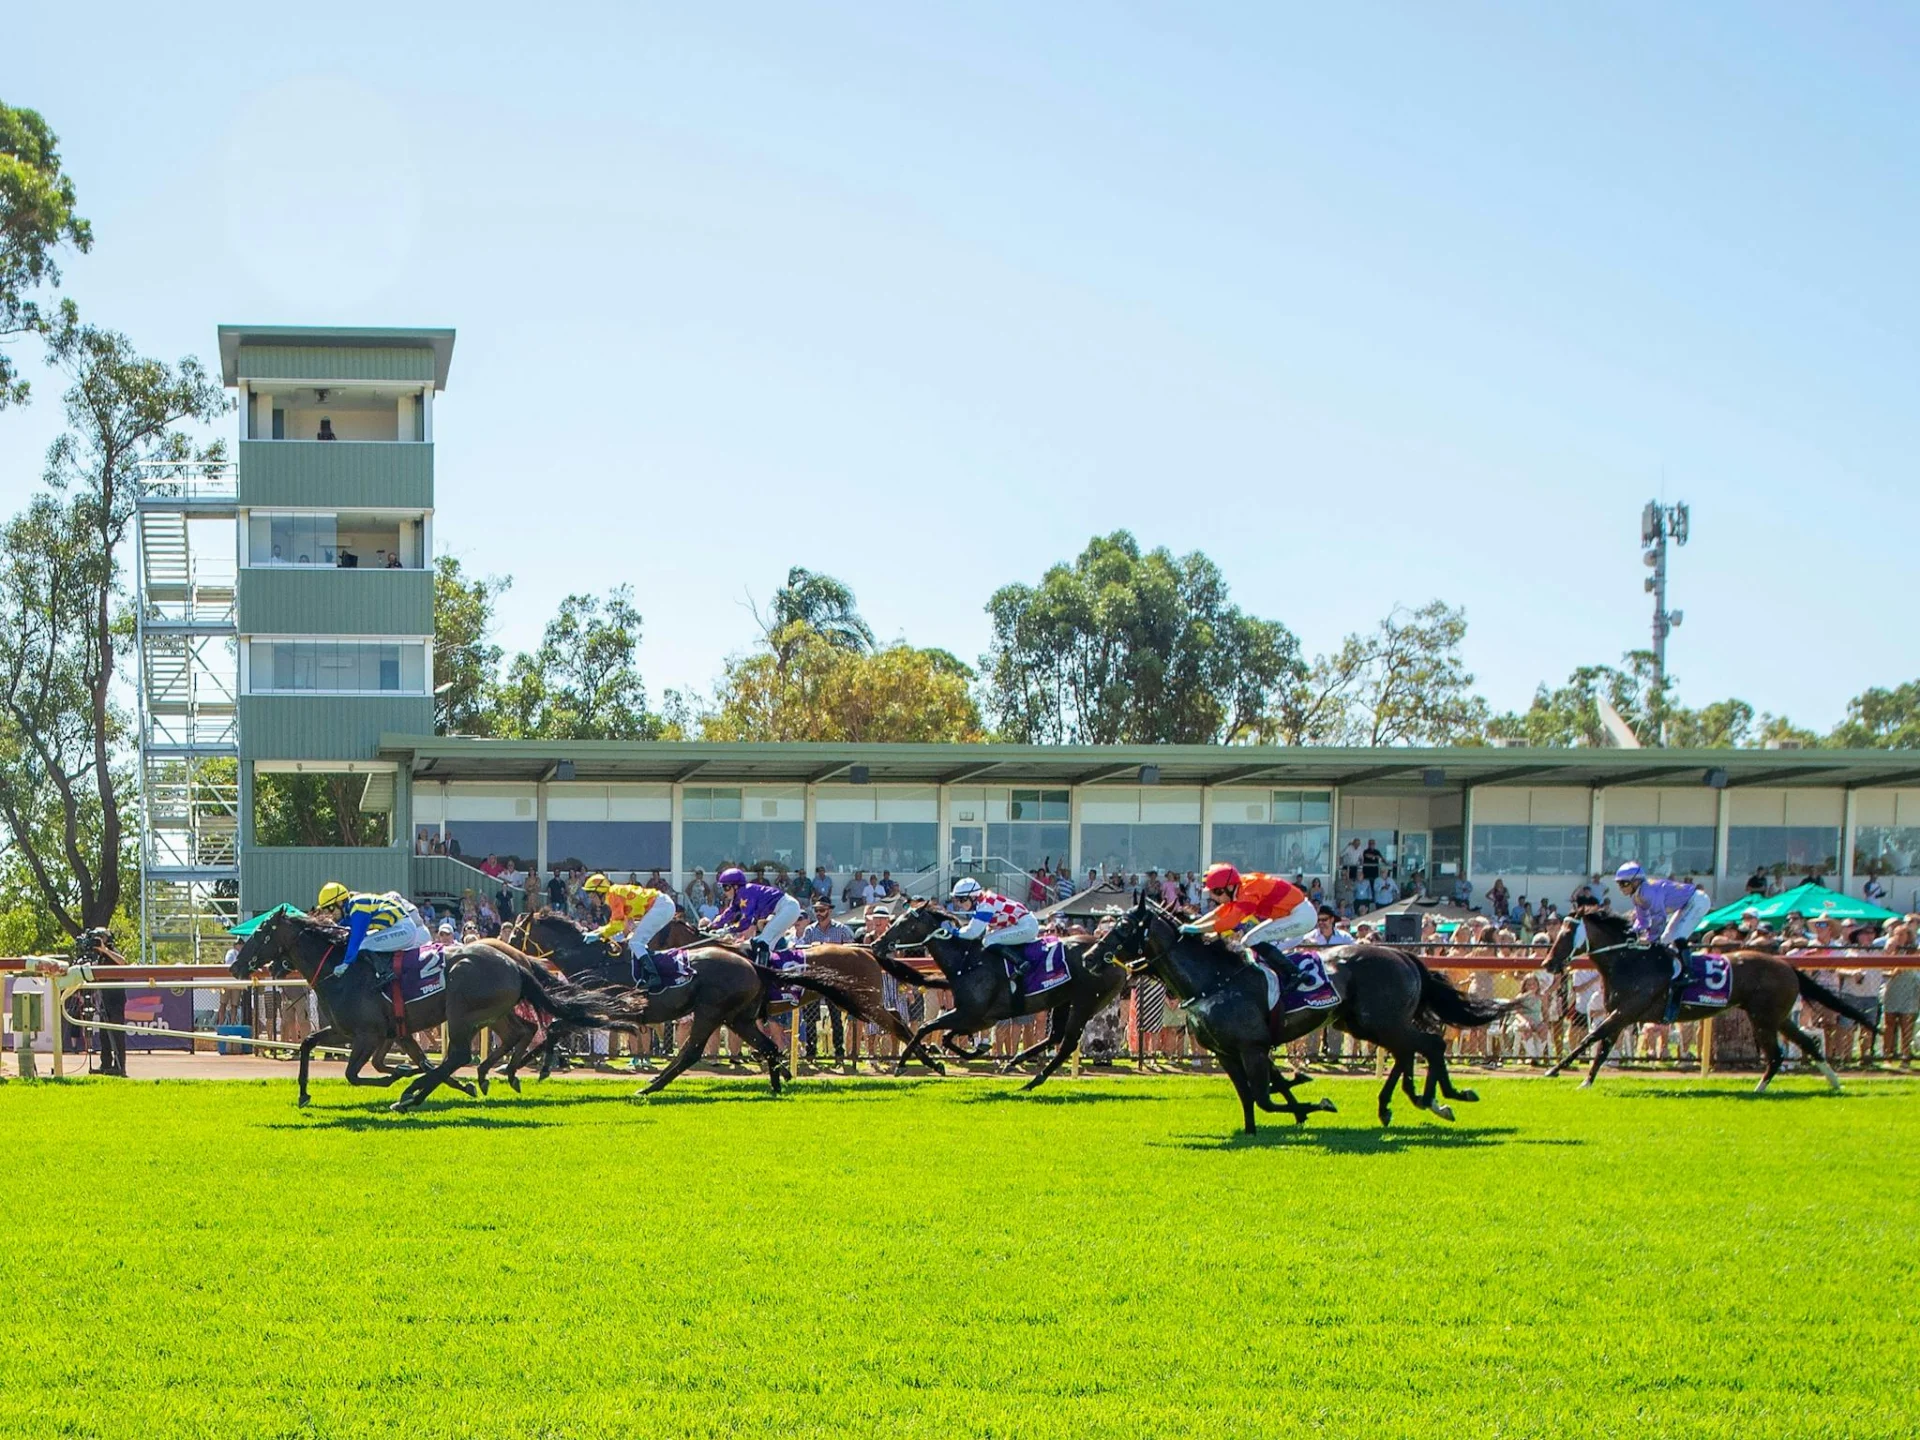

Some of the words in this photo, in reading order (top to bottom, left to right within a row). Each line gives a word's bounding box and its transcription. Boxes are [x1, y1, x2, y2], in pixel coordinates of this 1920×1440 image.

[419, 950, 441, 979] 2
[1042, 942, 1059, 973] 7
[1298, 958, 1325, 992] 3
[1705, 959, 1727, 990] 5
